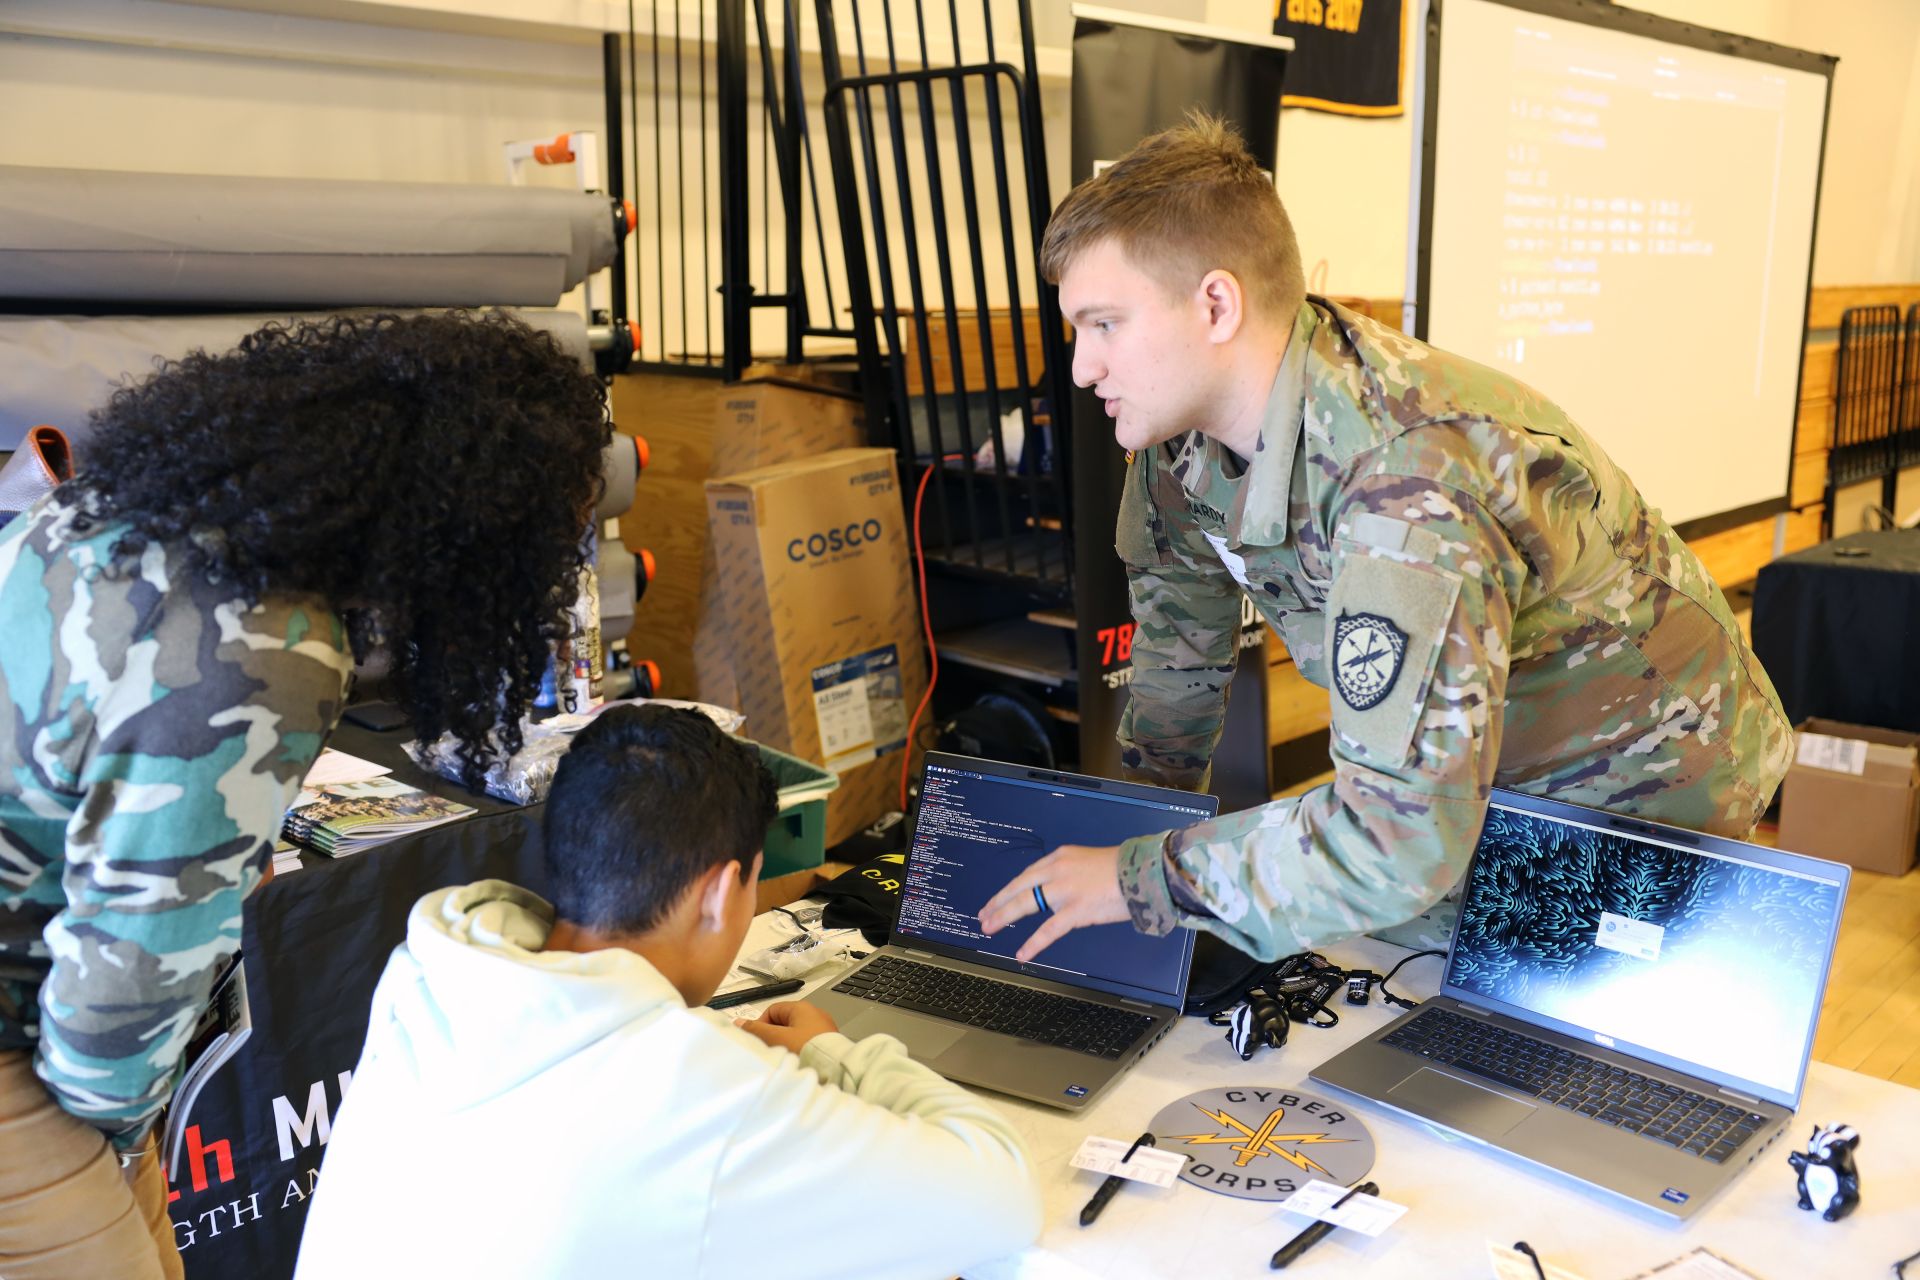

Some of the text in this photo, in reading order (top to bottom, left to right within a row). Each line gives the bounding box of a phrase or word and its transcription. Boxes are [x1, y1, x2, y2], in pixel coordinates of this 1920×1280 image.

[787, 518, 881, 562] COSCO
[1097, 622, 1139, 666] 78
[1225, 1090, 1346, 1126] CYBER
